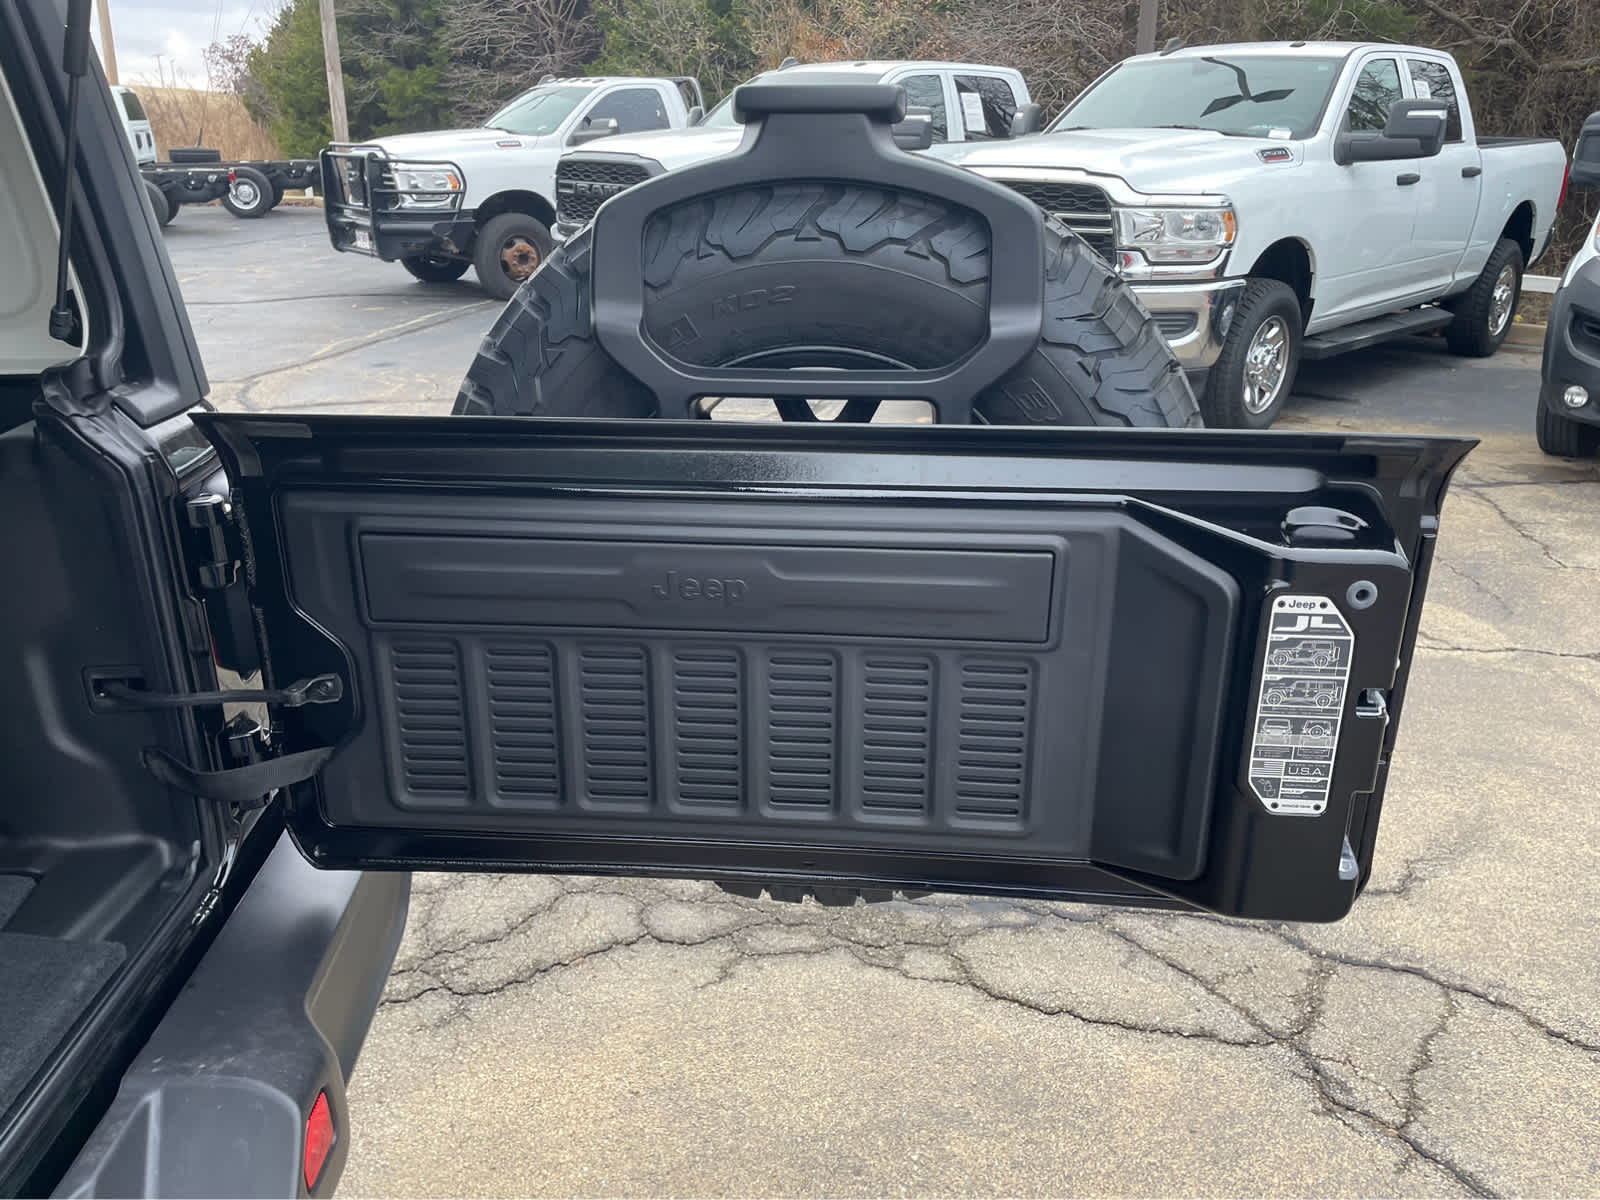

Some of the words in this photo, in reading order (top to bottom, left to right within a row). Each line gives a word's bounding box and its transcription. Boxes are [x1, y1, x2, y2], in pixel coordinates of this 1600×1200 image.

[651, 570, 749, 607] Jeep
[1288, 600, 1316, 610] Jeep
[1273, 615, 1342, 632] JL
